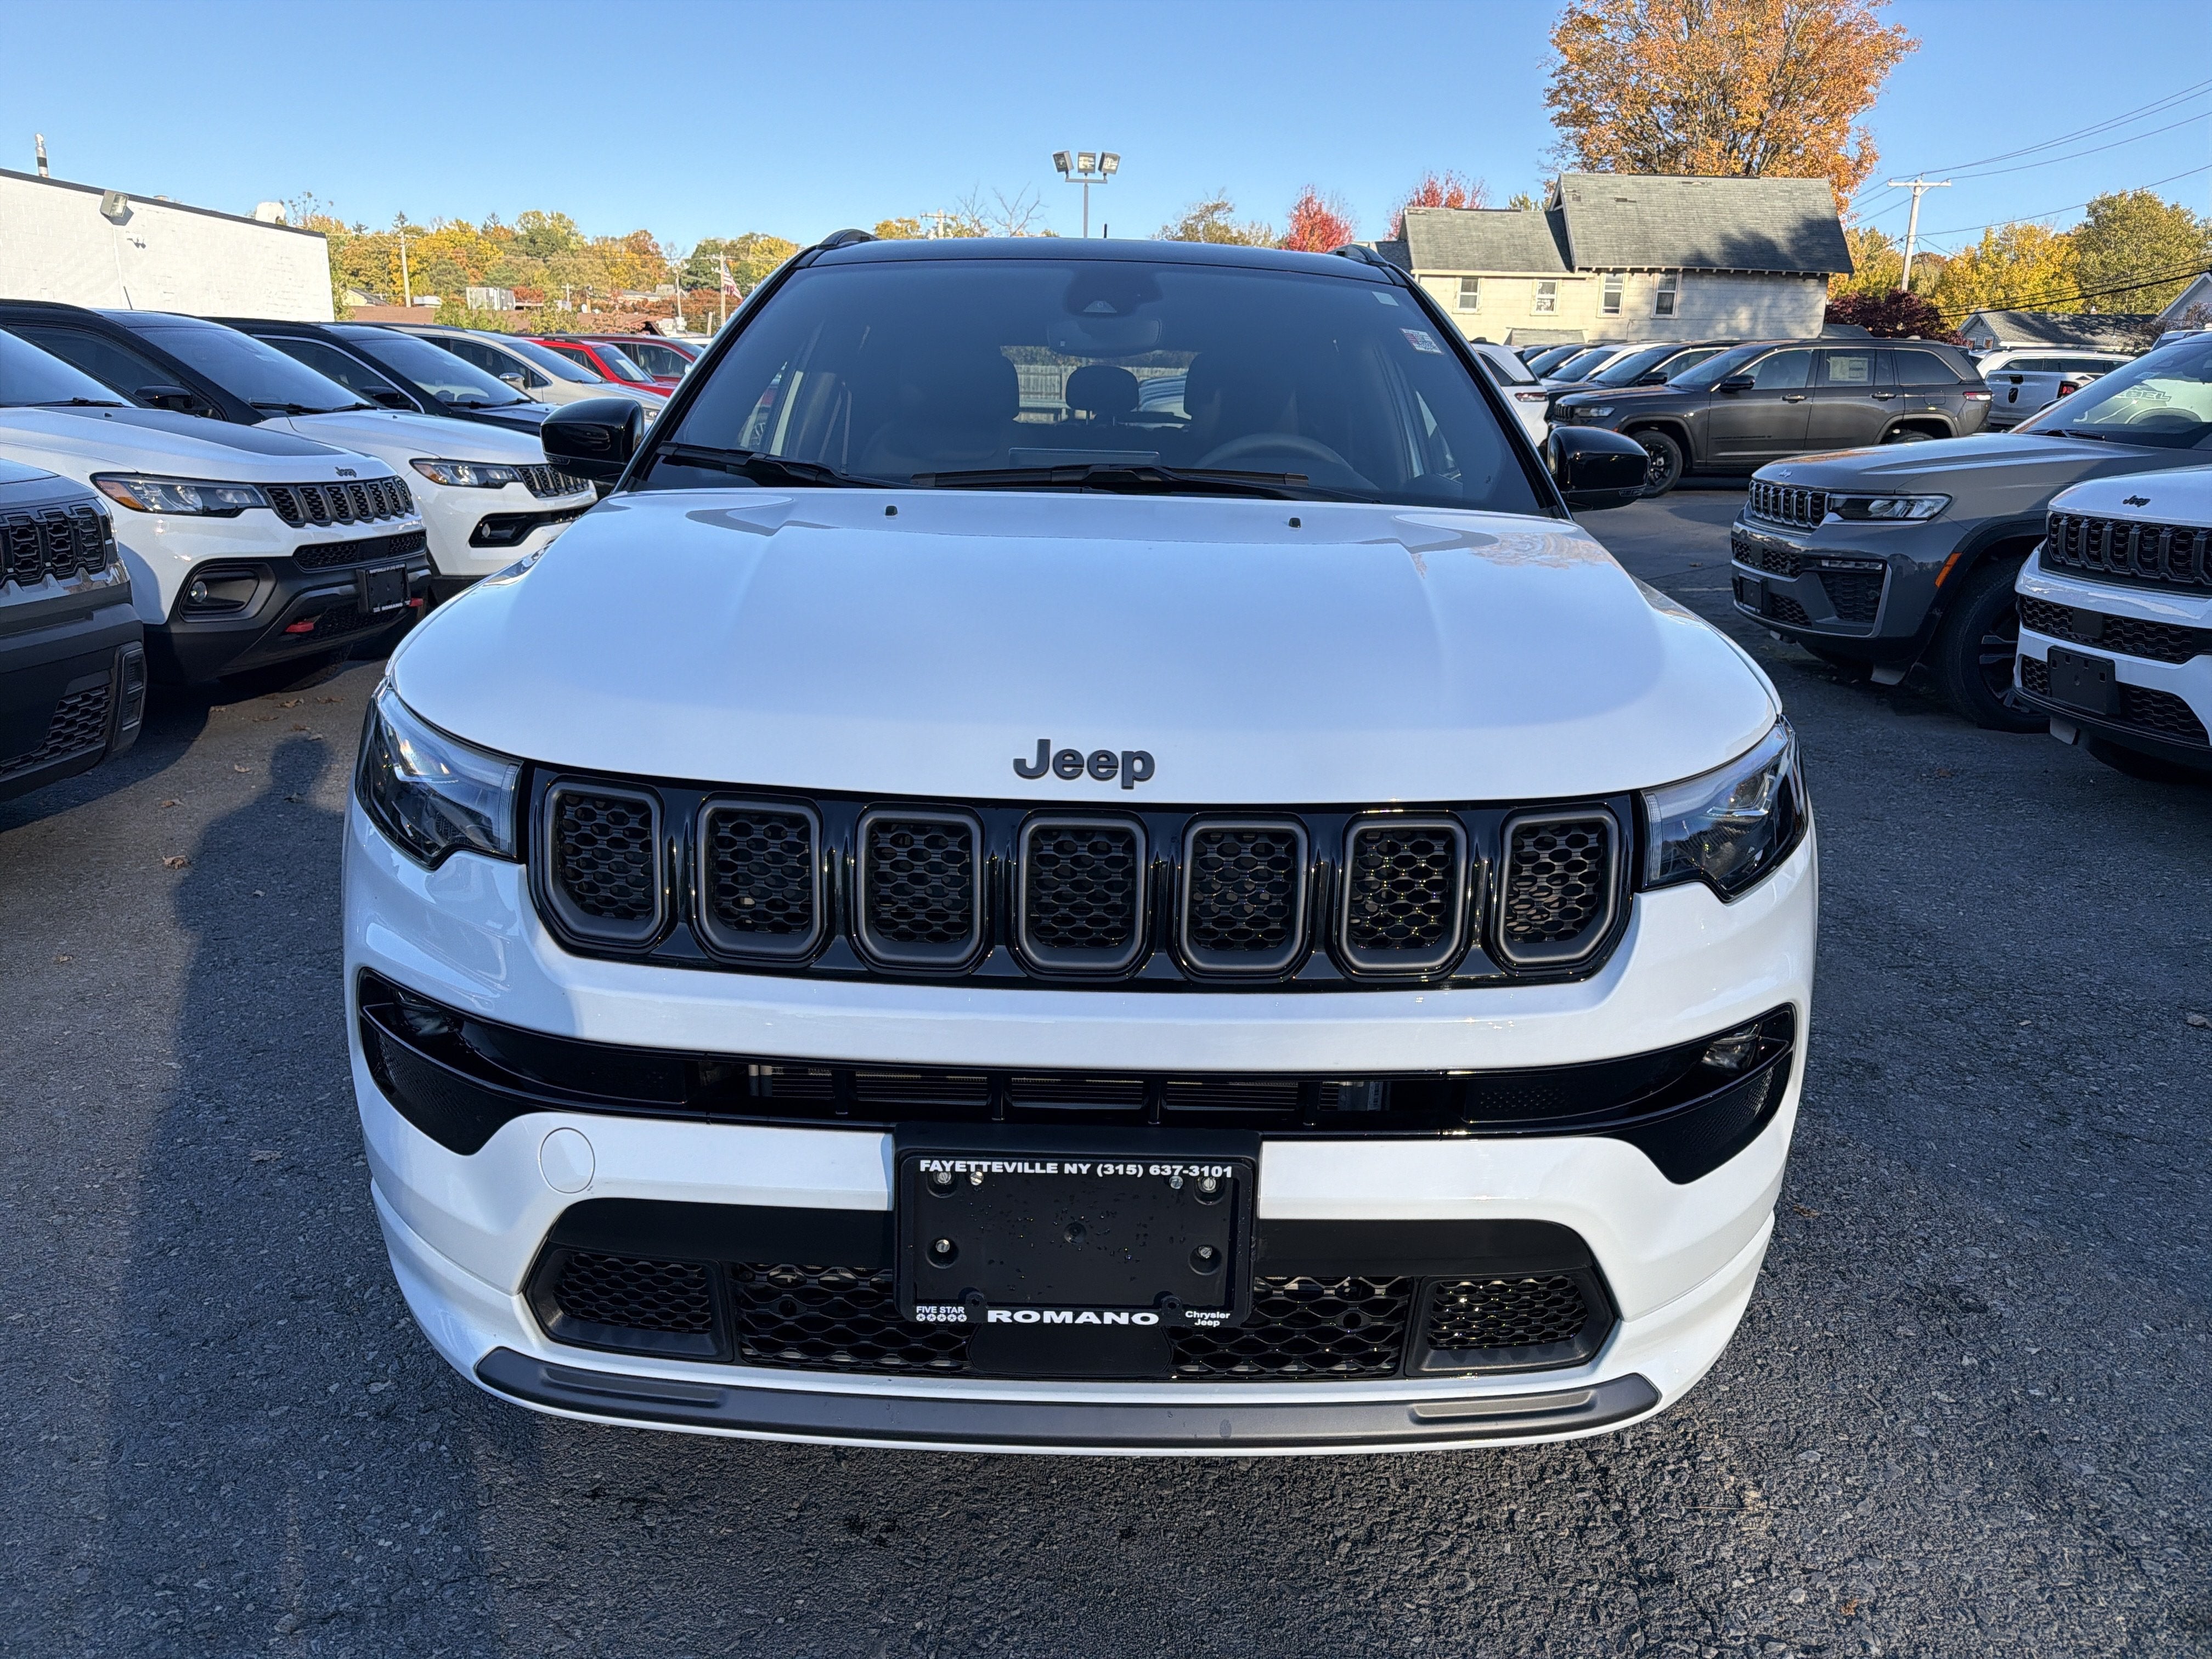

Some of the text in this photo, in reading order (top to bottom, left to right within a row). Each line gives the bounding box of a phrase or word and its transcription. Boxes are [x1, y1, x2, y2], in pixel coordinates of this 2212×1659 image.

[2115, 388, 2172, 402] BEL
[2123, 495, 2151, 508] Jeep
[1013, 738, 1155, 790] Jeep
[919, 1160, 1232, 1178] FAYETTEVILLE NY (315) 637-3101
[939, 1306, 965, 1314] STAR
[1185, 1311, 1231, 1319] Chrysler
[987, 1310, 1159, 1325] ROMANO
[1194, 1318, 1221, 1328] Jeep
